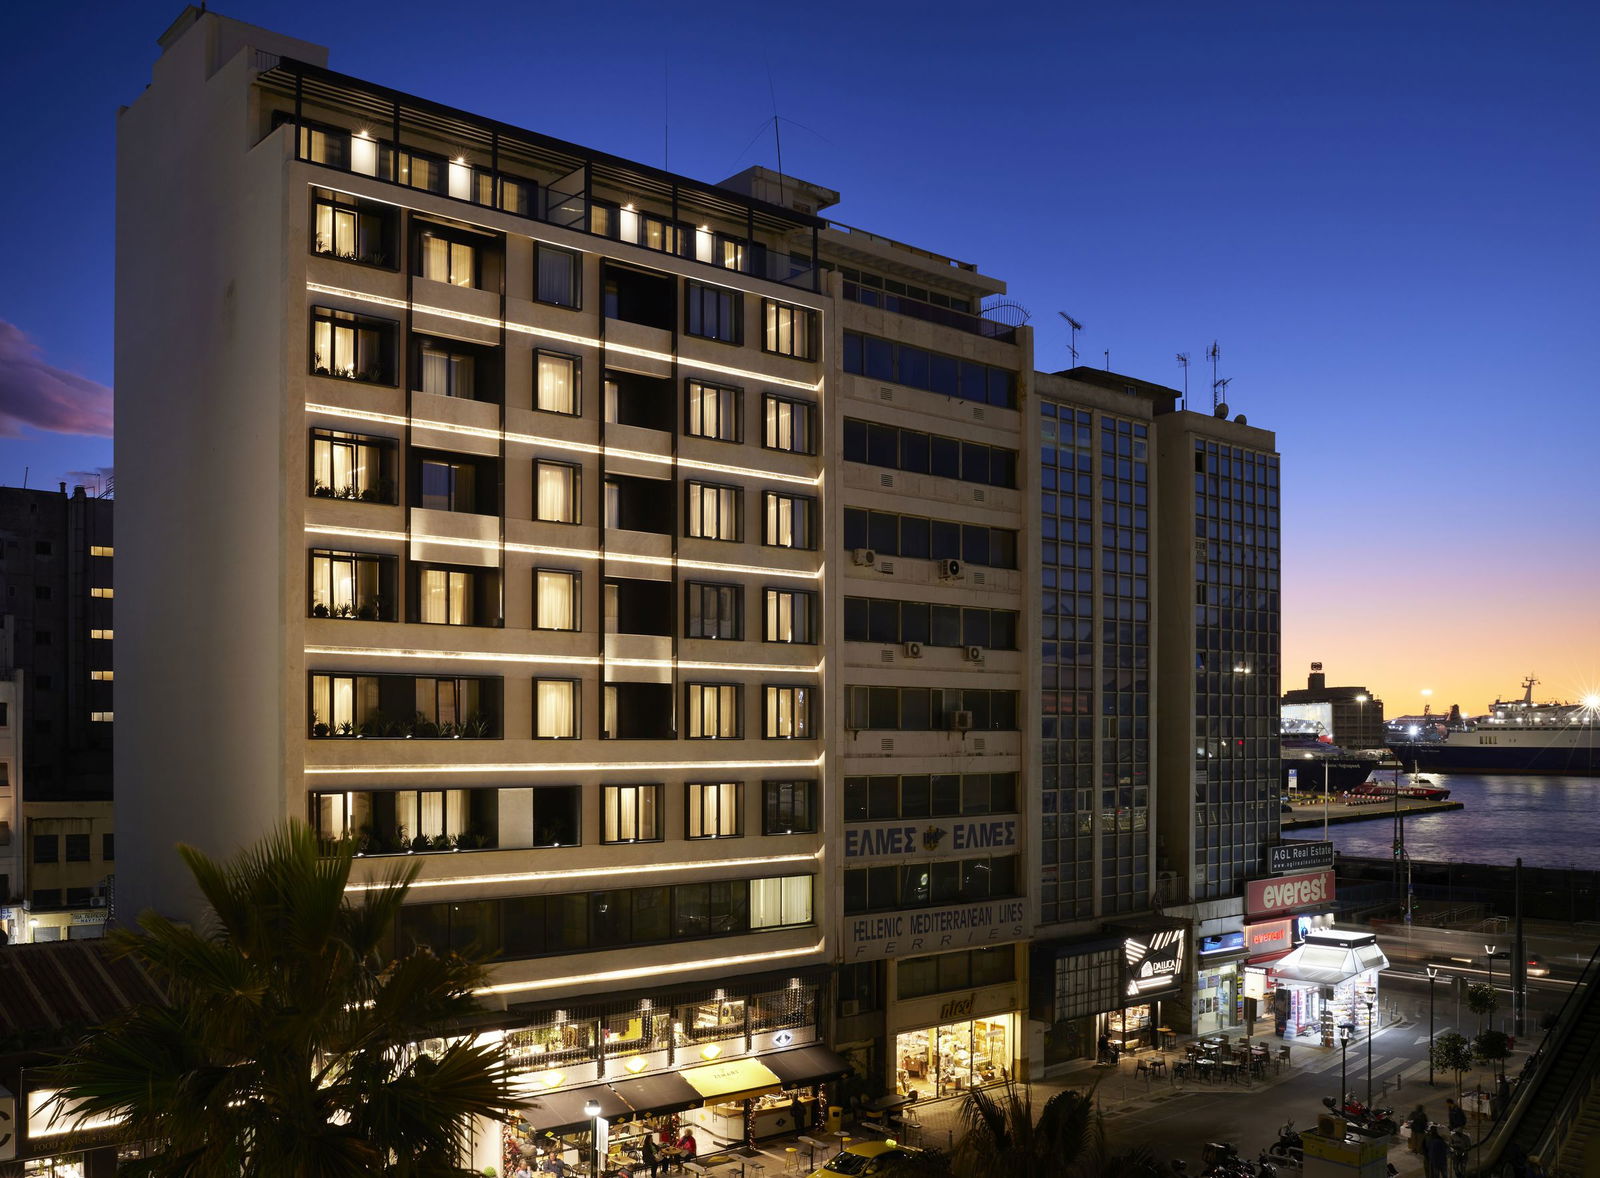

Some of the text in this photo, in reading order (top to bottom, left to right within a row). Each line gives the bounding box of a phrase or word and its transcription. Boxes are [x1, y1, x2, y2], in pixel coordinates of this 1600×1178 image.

[845, 827, 917, 857] ΕΛΜΕΣ
[953, 821, 1016, 850] ΕΛΜΕΣ
[1273, 845, 1332, 861] AGL Real Estate
[1263, 874, 1327, 909] everest
[854, 902, 1023, 942] HELLENIC MEDITERRANEAN LINES
[1253, 928, 1285, 945] everest
[855, 925, 1023, 957] FERRIES
